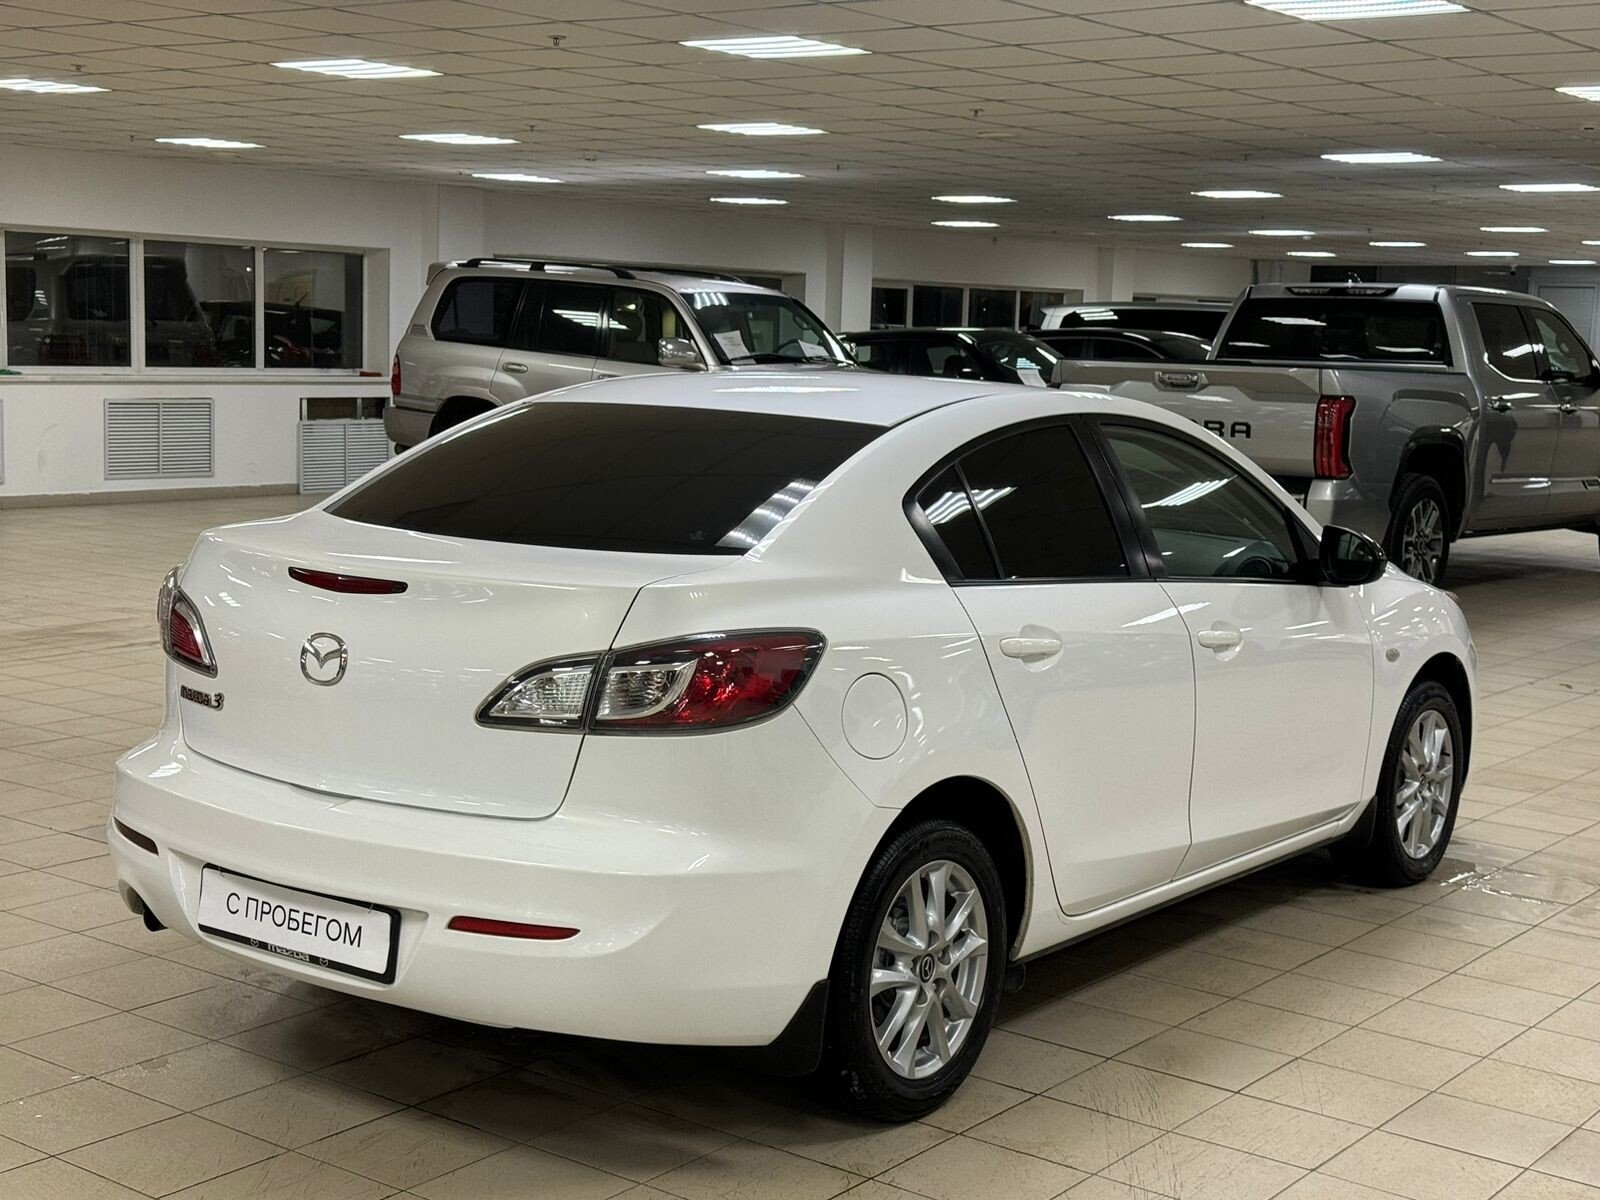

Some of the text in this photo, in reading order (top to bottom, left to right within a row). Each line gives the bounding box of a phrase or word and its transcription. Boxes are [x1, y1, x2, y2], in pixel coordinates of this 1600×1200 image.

[1189, 418, 1251, 439] RA
[226, 892, 363, 948] С ПРОБЕГОМ
